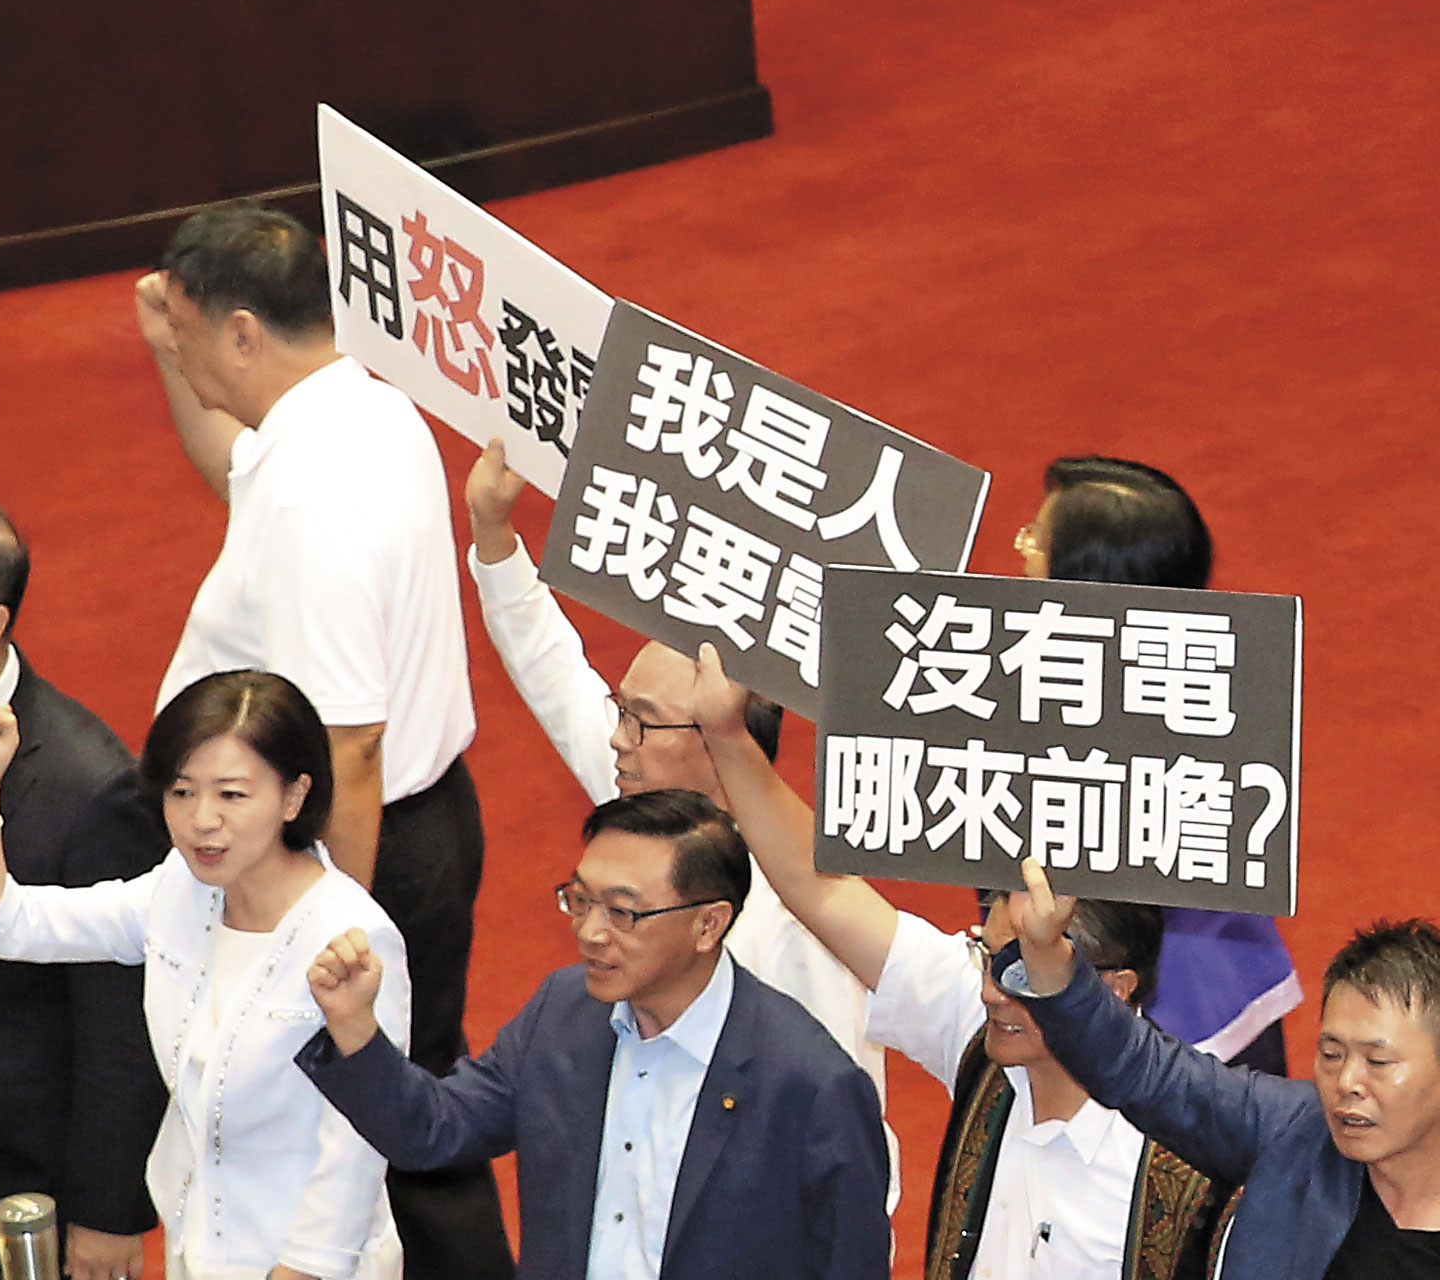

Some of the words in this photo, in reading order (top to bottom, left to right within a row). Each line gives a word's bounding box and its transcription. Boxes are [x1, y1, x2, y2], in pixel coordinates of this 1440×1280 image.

[336, 188, 595, 458] 用怒發
[625, 342, 922, 573] 我是人
[881, 593, 1237, 737] 沒有電
[822, 734, 1290, 888] 哪來前瞻?
